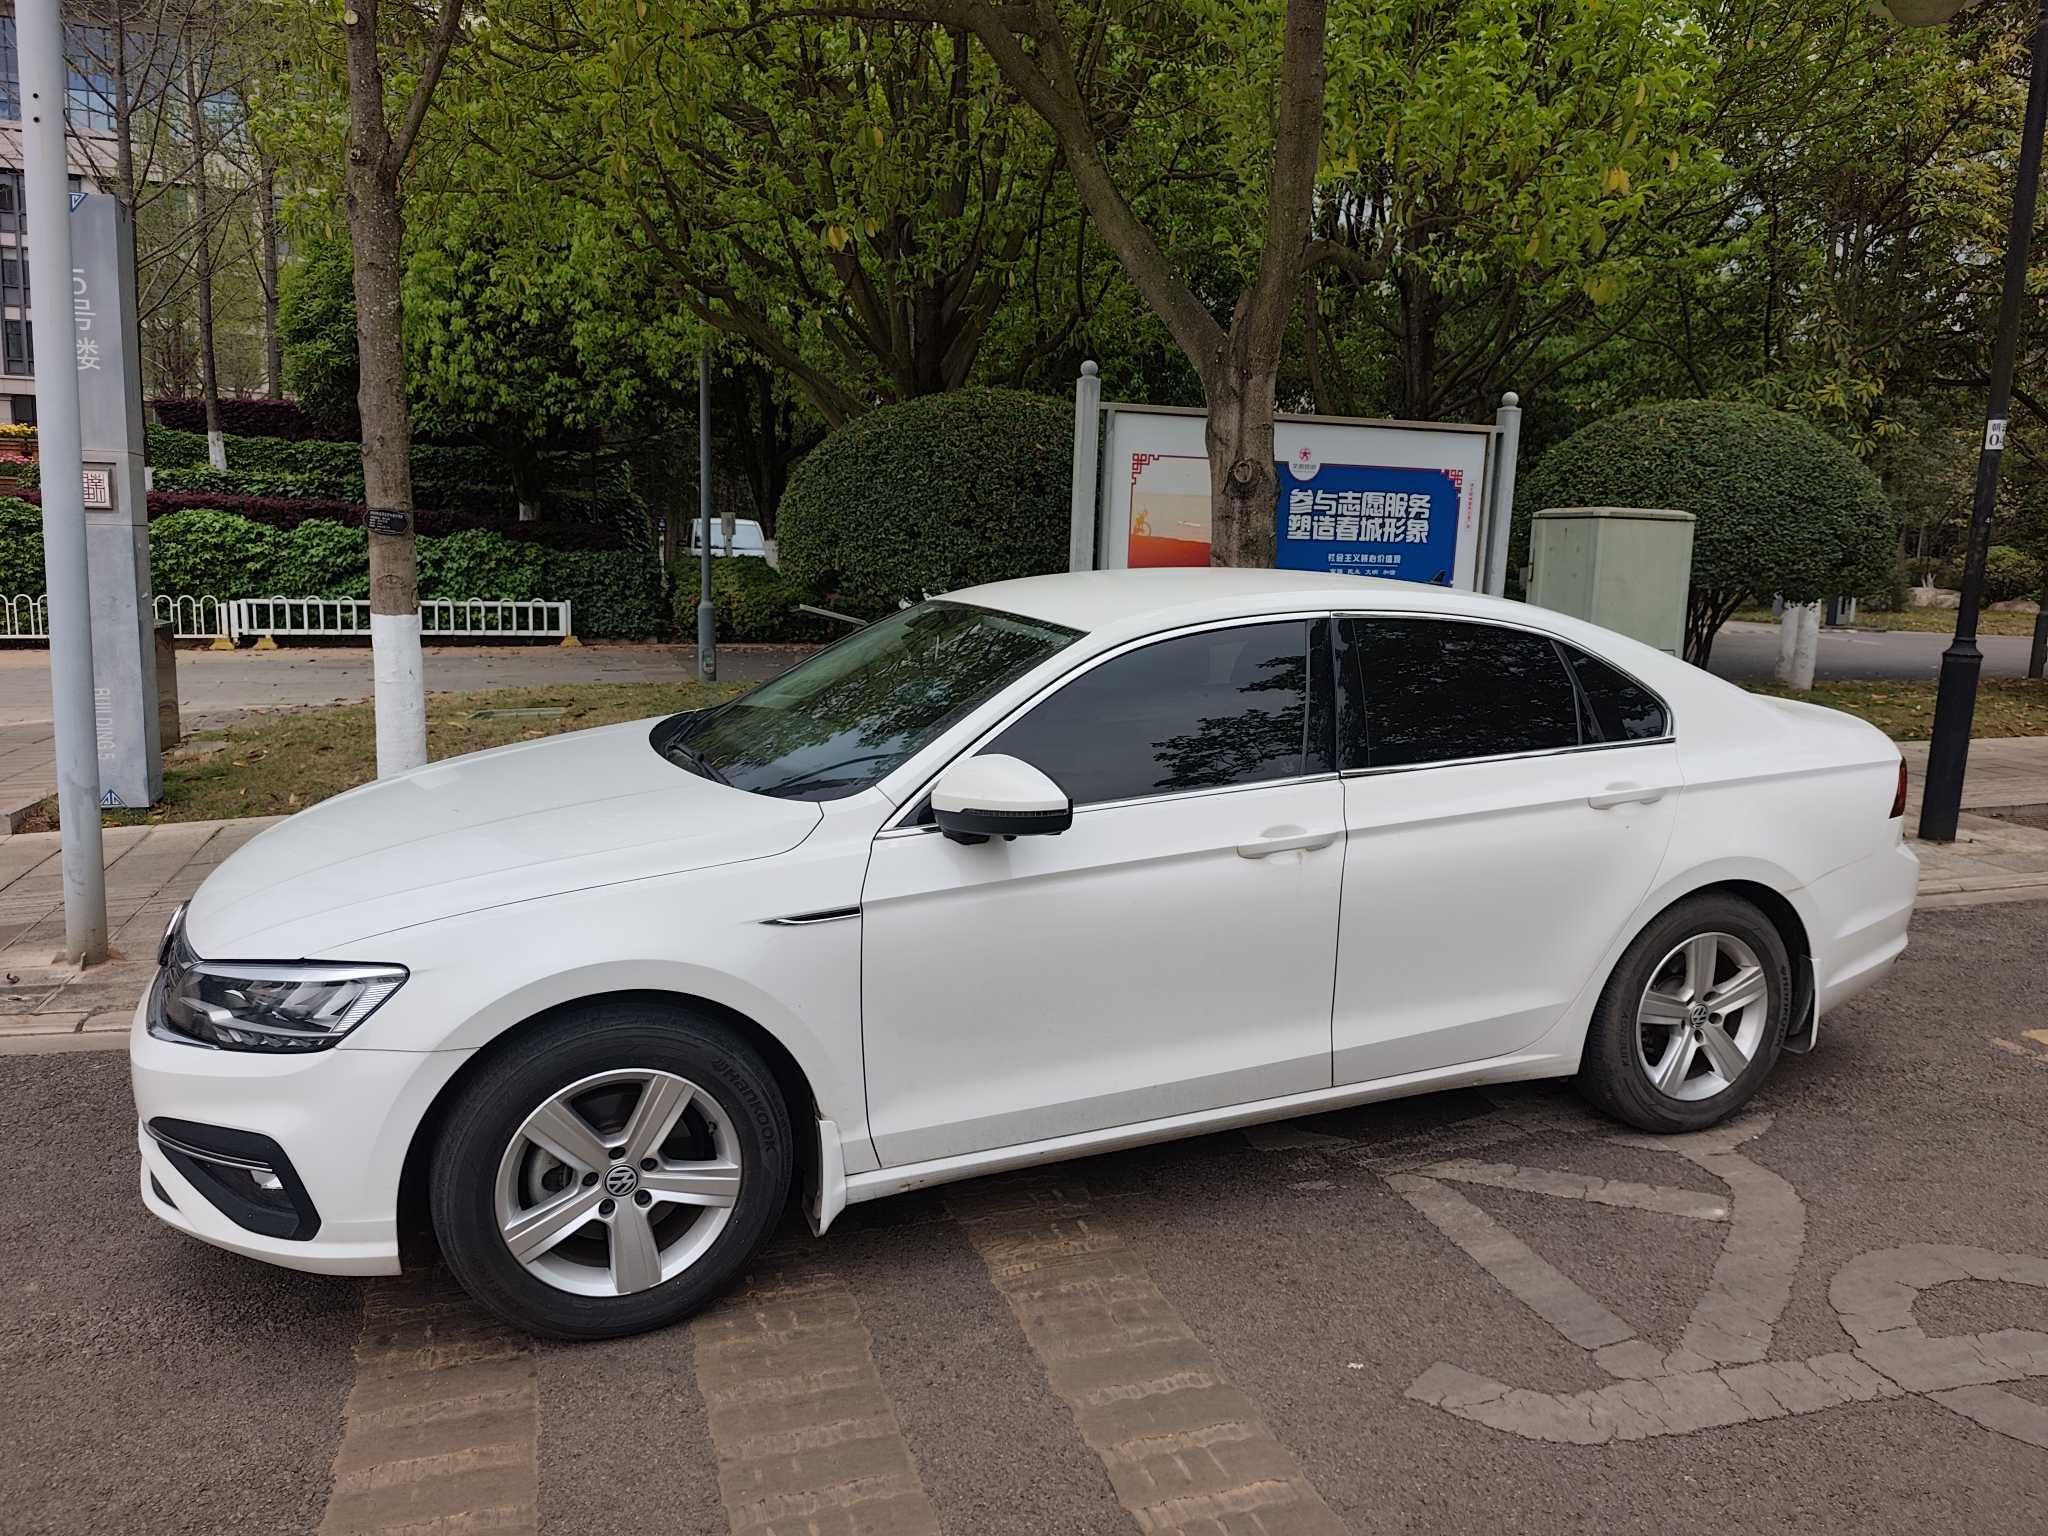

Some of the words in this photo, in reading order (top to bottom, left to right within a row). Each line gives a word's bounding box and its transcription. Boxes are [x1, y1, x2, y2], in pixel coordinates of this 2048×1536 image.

[1289, 488, 1431, 519] 参与志愿服务
[1287, 514, 1430, 543] 塑造春城形象
[1327, 553, 1401, 564] 社会主义核心价值观
